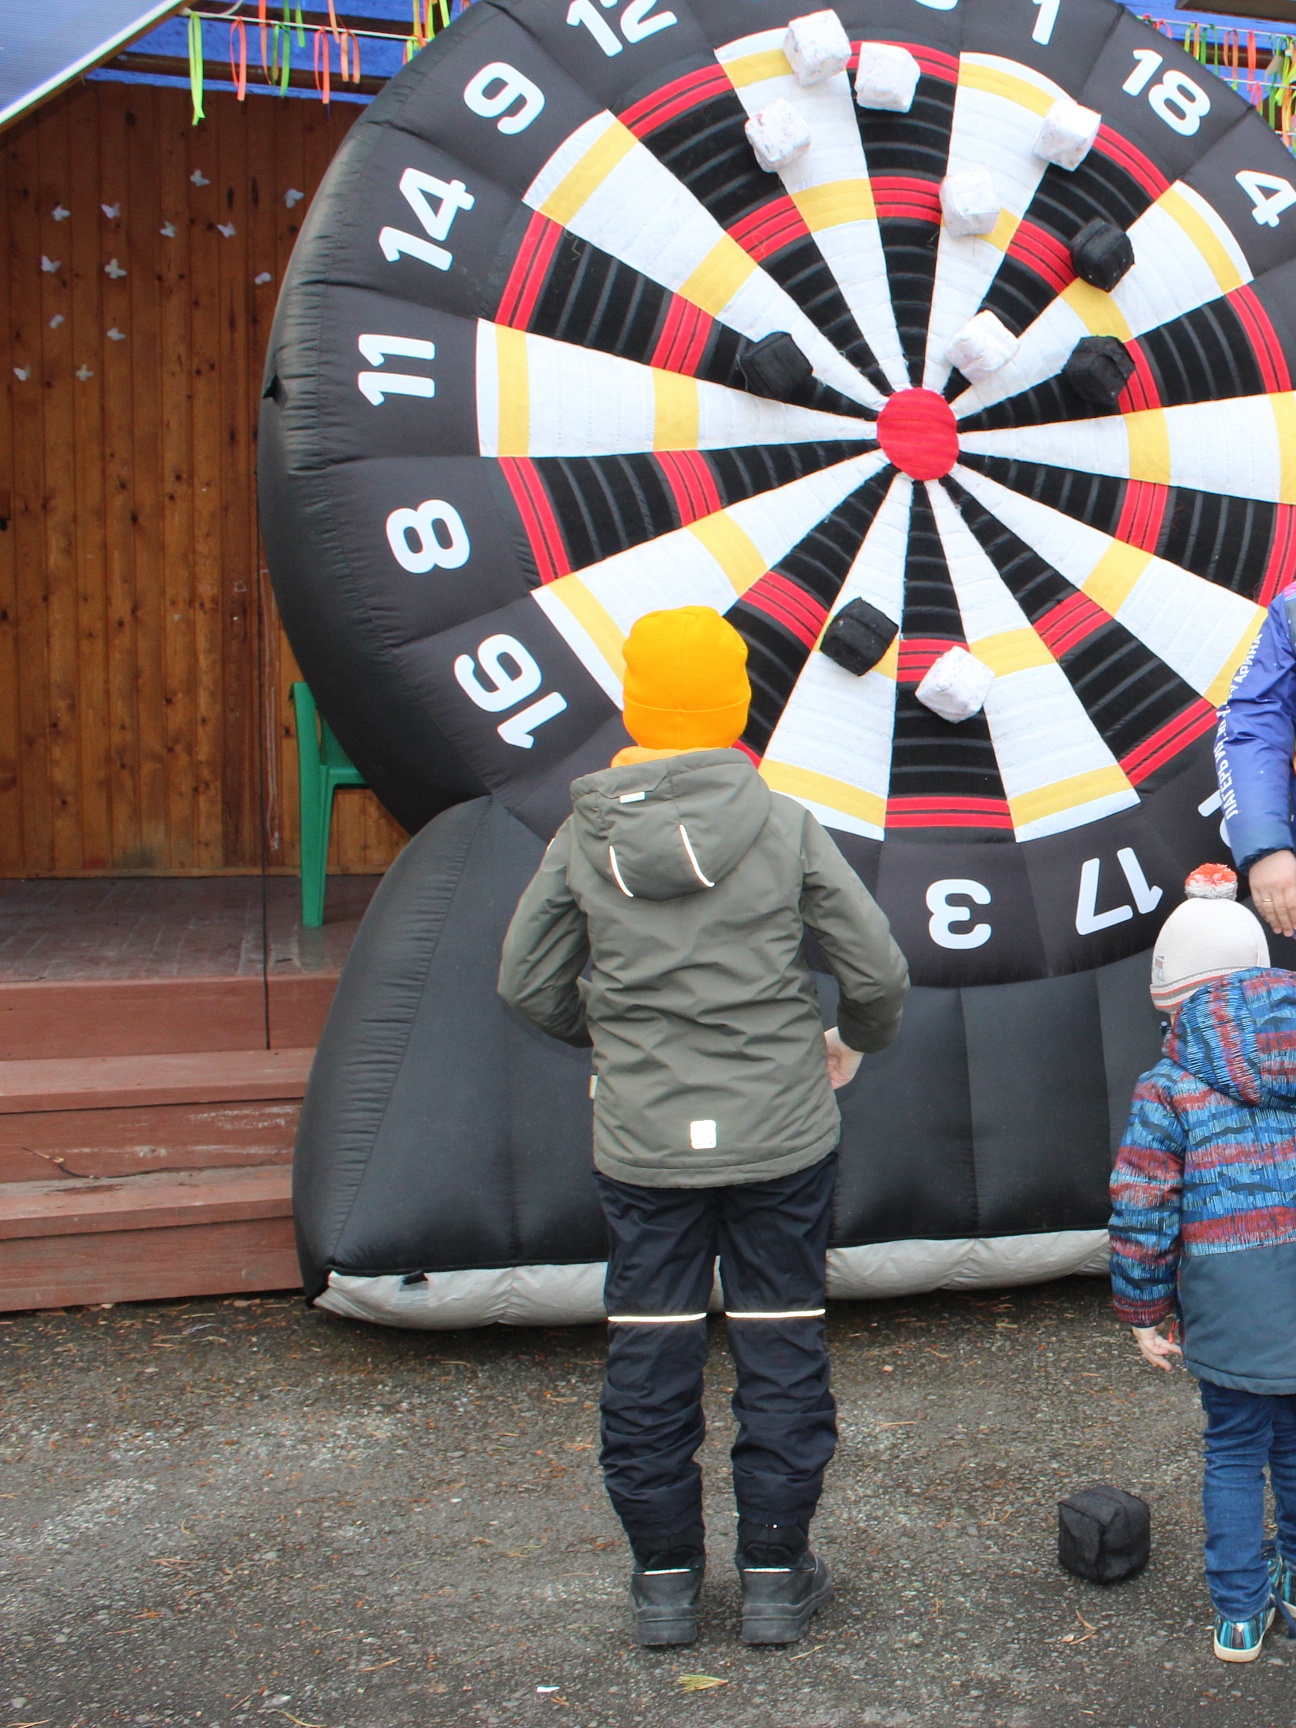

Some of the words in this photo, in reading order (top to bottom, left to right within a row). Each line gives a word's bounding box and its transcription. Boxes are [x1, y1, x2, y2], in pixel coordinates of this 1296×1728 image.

[464, 61, 545, 135] 9
[1122, 49, 1211, 136] 18
[378, 167, 475, 271] 14
[358, 333, 435, 406] 11
[386, 499, 471, 574] 8
[454, 633, 568, 749] 16
[1217, 758, 1240, 821] ЛАГЕРЬ
[925, 879, 992, 950] 3
[1075, 847, 1163, 936] 17
